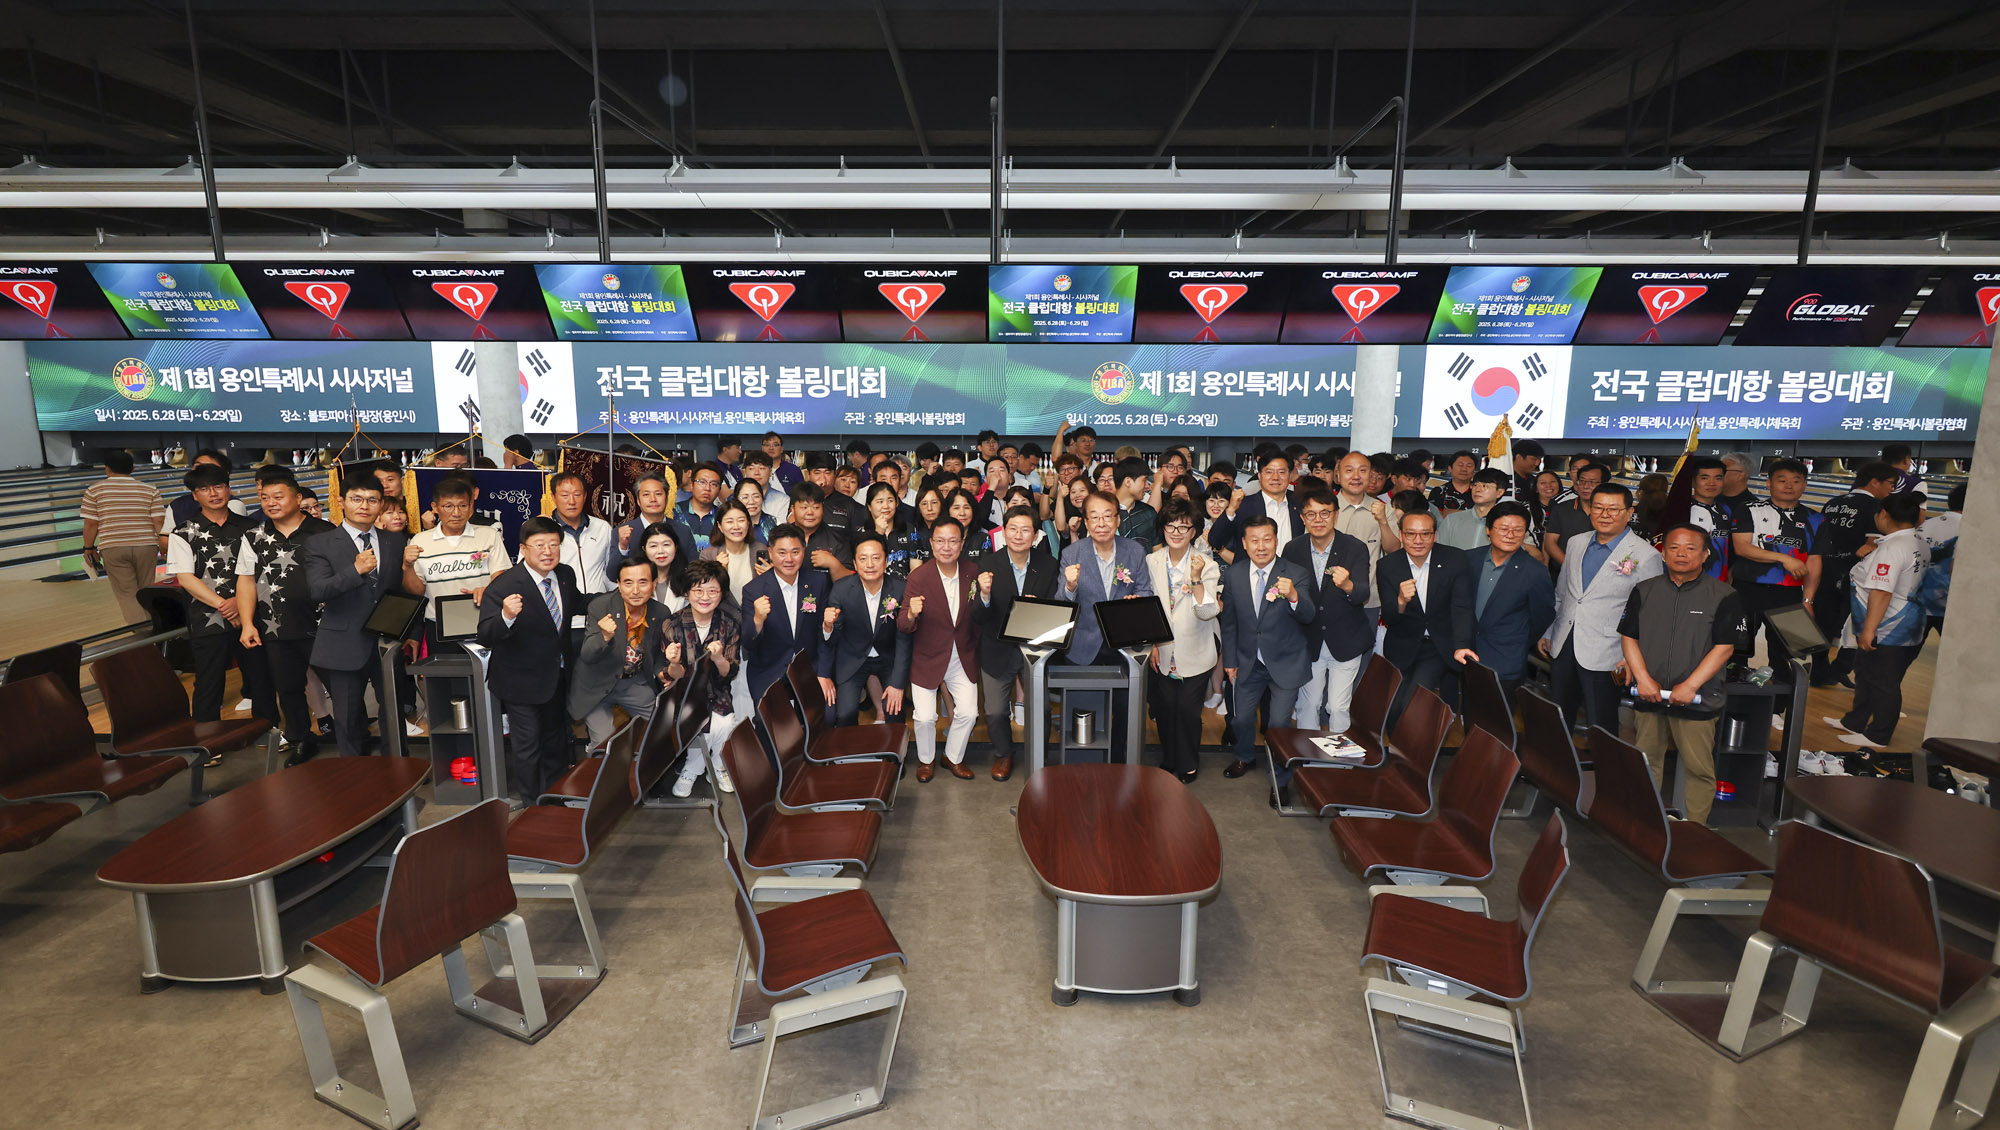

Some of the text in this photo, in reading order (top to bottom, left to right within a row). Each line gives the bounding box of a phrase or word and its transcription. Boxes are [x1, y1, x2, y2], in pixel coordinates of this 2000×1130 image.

[123, 299, 240, 311] 전국 클럽대항 볼링대회
[560, 301, 676, 313] 전국 클럽대항 볼링대회
[1003, 302, 1119, 314] 전국 클럽대항 볼링대회
[1452, 303, 1572, 315] 전국 클럽대항 볼링대회
[1794, 304, 1870, 315] GLOBAL
[122, 375, 145, 384] YIBA
[159, 367, 414, 393] 제 1회 용인특례시 시사저널
[596, 365, 886, 398] 전국 클럽대항 볼링대회
[1102, 379, 1124, 388] YIBA
[1139, 370, 1161, 396] 제
[1166, 370, 1196, 396] 1회
[1201, 370, 1309, 397] 용인특례시
[1591, 369, 1894, 404] 전국 클럽대항 볼링대회
[95, 409, 115, 422] 일시
[122, 410, 151, 421] 2025.
[152, 410, 175, 421] 6.28
[280, 410, 301, 423] 장소
[308, 410, 349, 423] 볼토피아
[844, 412, 865, 425] 주관
[874, 412, 965, 425] 용인특례시볼링협회
[1066, 413, 1087, 426] 일시
[1094, 414, 1123, 425] 2025.
[1125, 414, 1149, 425] 6.28
[1258, 414, 1279, 427] 장소
[1286, 414, 1328, 427] 볼토피아
[1587, 416, 1609, 429] 주최
[1841, 417, 1864, 430] 주관
[1872, 418, 1967, 431] 용인특례시볼링협회
[602, 490, 625, 517] 祝
